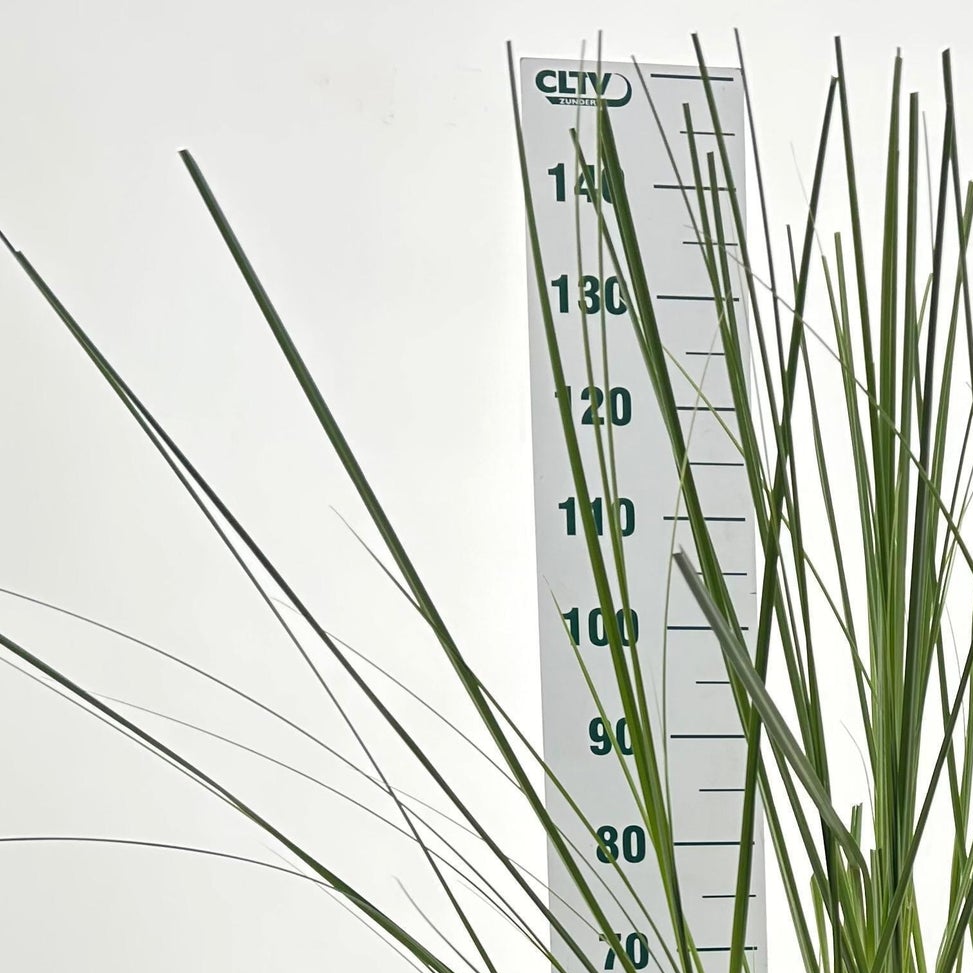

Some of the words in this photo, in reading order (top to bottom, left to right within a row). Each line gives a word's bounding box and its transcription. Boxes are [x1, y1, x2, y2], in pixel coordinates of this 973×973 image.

[535, 69, 612, 96] CLTV
[559, 98, 597, 106] ZUNDER
[551, 274, 628, 315] 130
[555, 386, 631, 427] 20
[558, 497, 635, 537] 110
[561, 607, 639, 647] 100
[589, 717, 637, 756] 90
[596, 825, 647, 863] 80
[599, 932, 649, 970] 70
